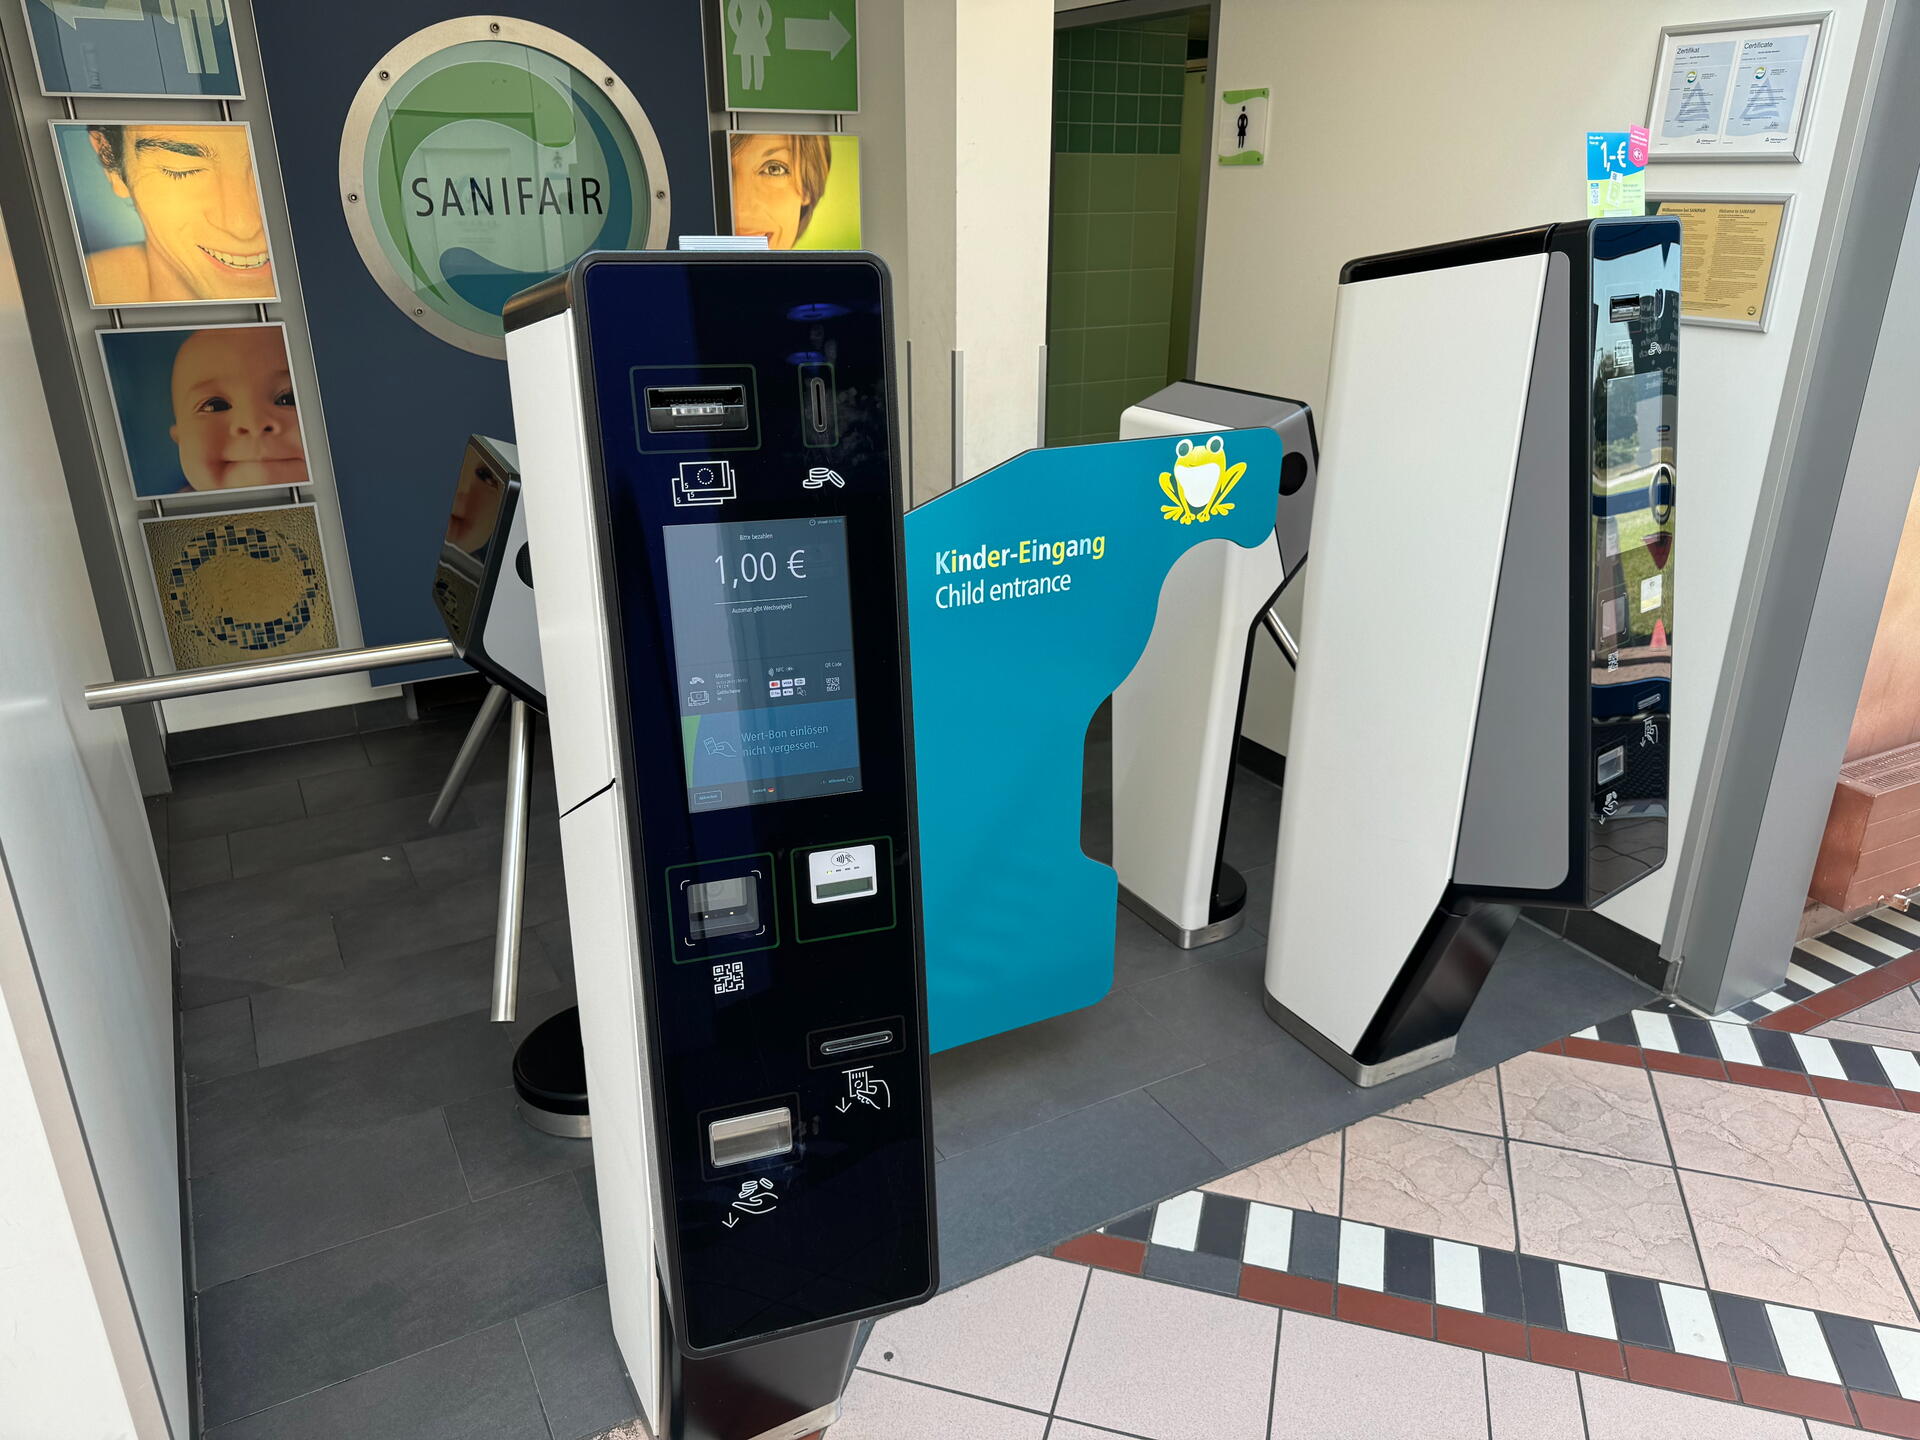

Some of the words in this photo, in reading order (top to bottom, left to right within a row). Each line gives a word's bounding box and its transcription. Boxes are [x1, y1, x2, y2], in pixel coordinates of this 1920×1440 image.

[1676, 47, 1699, 55] Zertifikat
[1744, 41, 1773, 49] Certificate
[411, 176, 604, 218] SANIFAIR
[751, 532, 774, 540] bezahlen
[935, 535, 1105, 575] Kinder-Eingang
[714, 551, 777, 589] 1,00
[786, 549, 807, 579] €
[934, 579, 985, 609] Child
[989, 573, 1072, 602] entrance
[731, 606, 753, 614] Automat
[763, 602, 793, 613] Wechselgeld
[741, 728, 787, 743] Wert-Bon
[790, 724, 829, 738] einlösen
[743, 743, 767, 757] nicht
[769, 741, 819, 756] vergessen.
